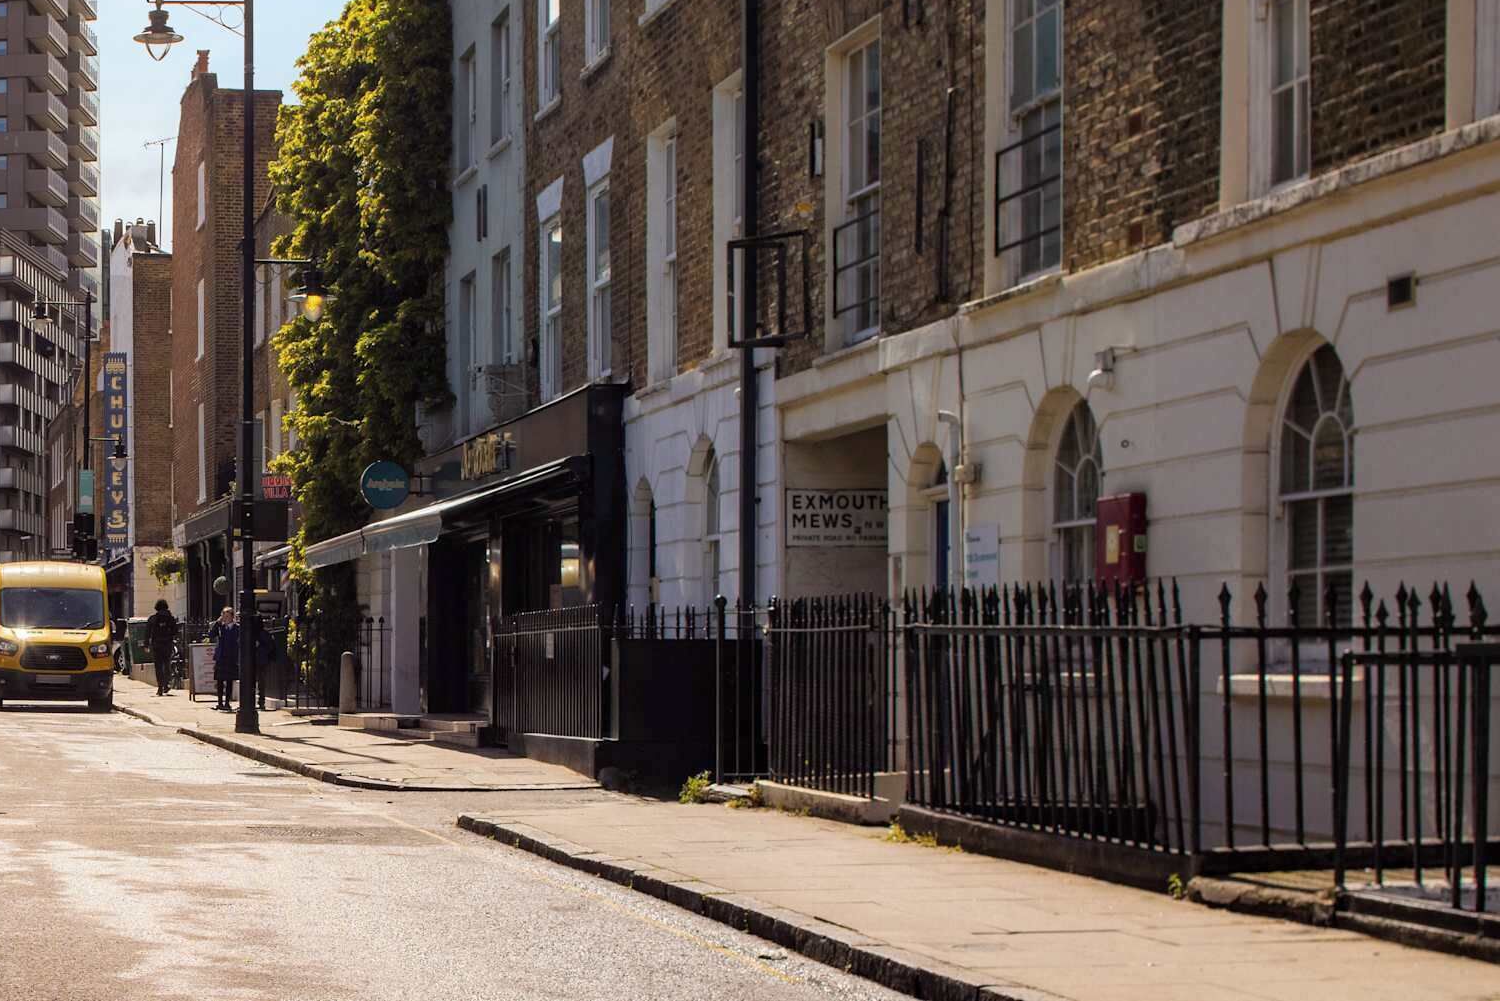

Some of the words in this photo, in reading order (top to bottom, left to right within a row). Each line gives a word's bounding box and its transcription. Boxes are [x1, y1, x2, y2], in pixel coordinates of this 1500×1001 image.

[110, 376, 124, 523] CHUTEYS
[263, 486, 289, 498] VILLA
[792, 495, 889, 510] EXMOUTH
[792, 513, 853, 528] MEWS
